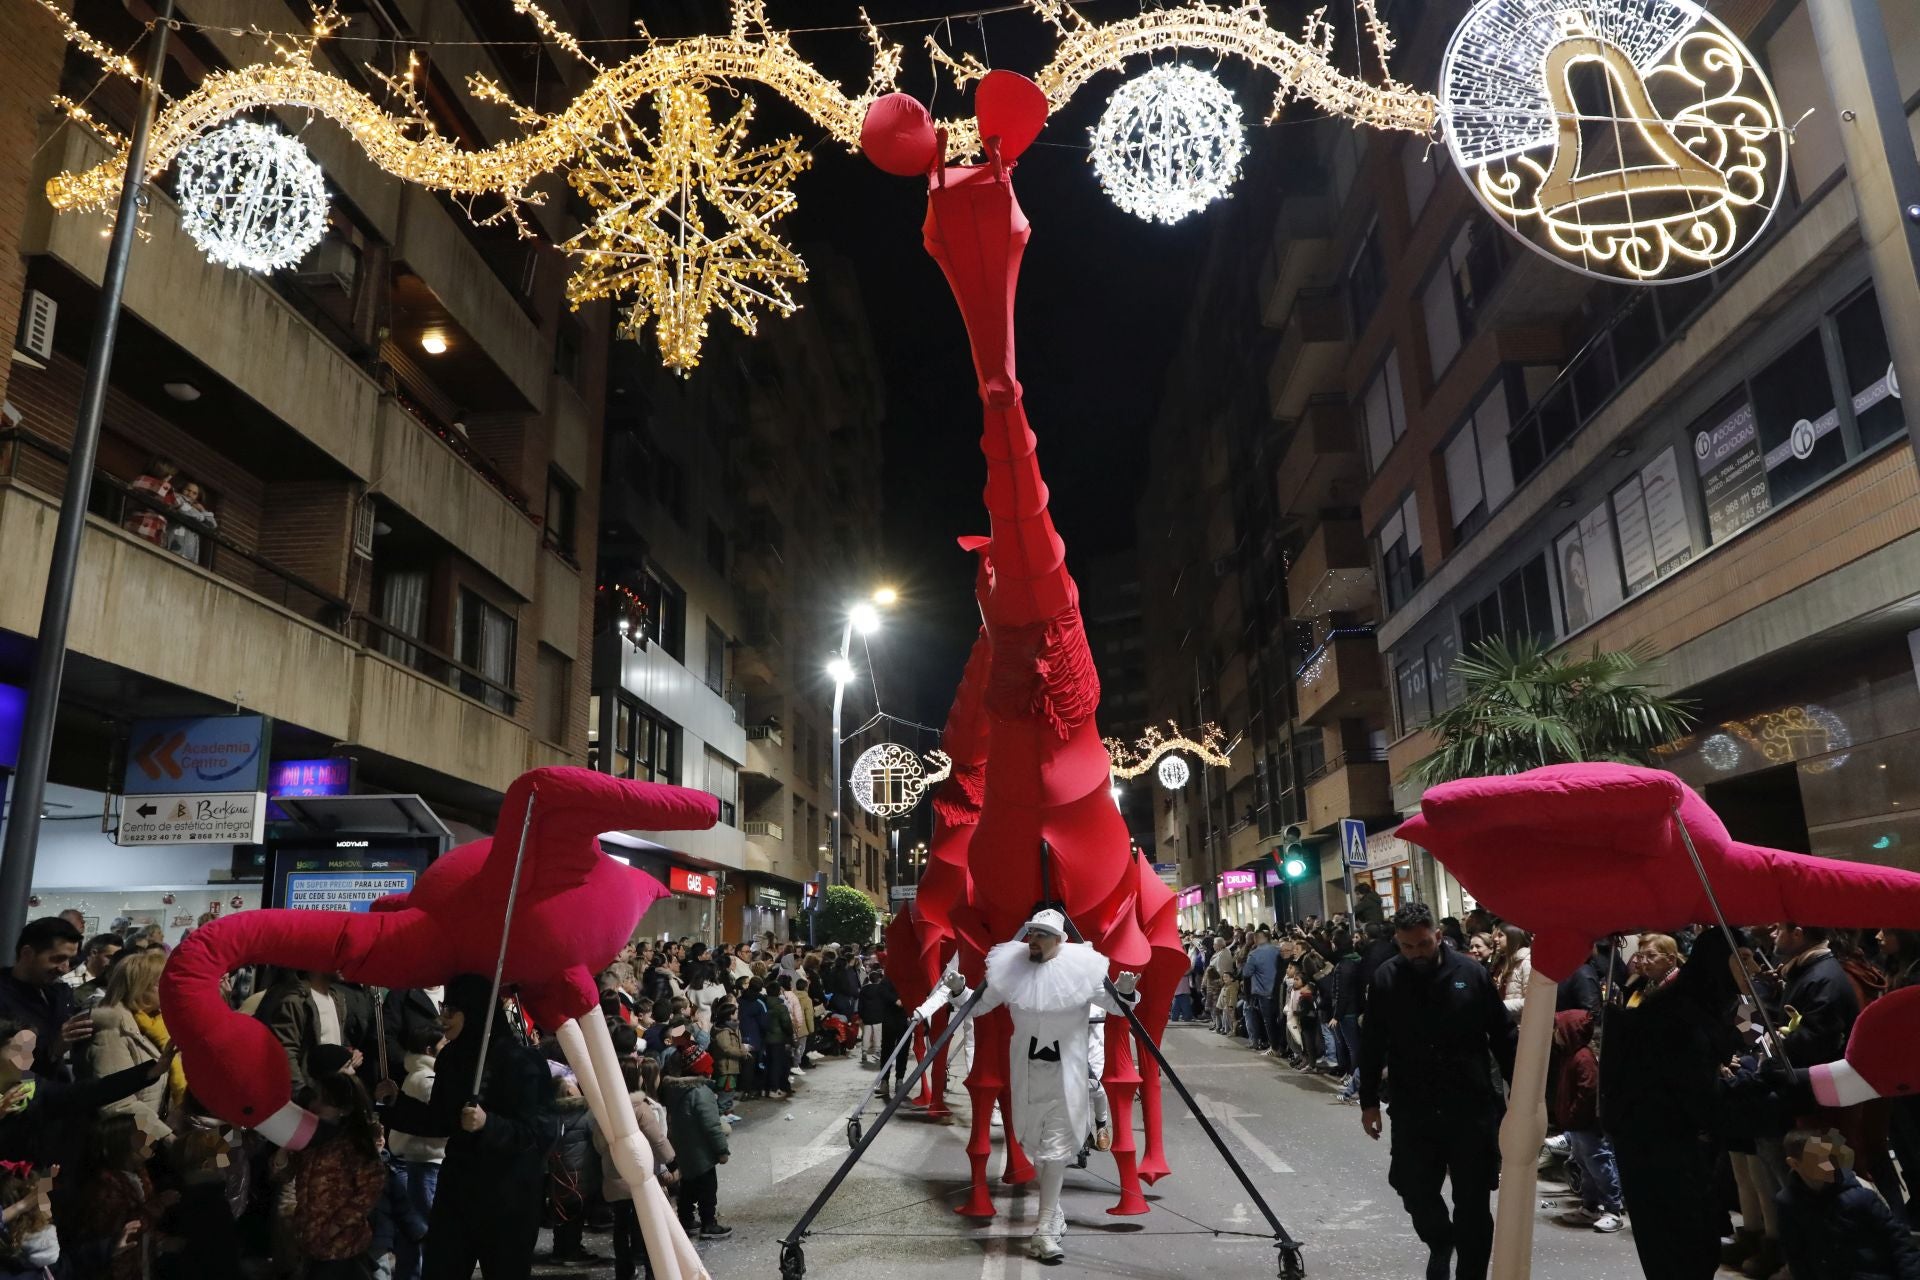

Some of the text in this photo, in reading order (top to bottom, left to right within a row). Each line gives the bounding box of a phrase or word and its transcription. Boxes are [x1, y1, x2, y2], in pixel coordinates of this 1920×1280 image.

[1751, 482, 1766, 499] 929
[182, 742, 251, 755] Academia
[181, 757, 228, 768] Centro
[303, 765, 315, 785] DE
[122, 819, 252, 833] Centro de estética integral
[295, 880, 305, 888] UN
[329, 880, 353, 888] PRECIO
[354, 880, 371, 888] PARA
[687, 873, 702, 892] GAES
[1226, 874, 1252, 884] DRUNI
[294, 892, 307, 900] QUE
[308, 892, 325, 900] CEDE
[338, 892, 366, 900] ASIENTO
